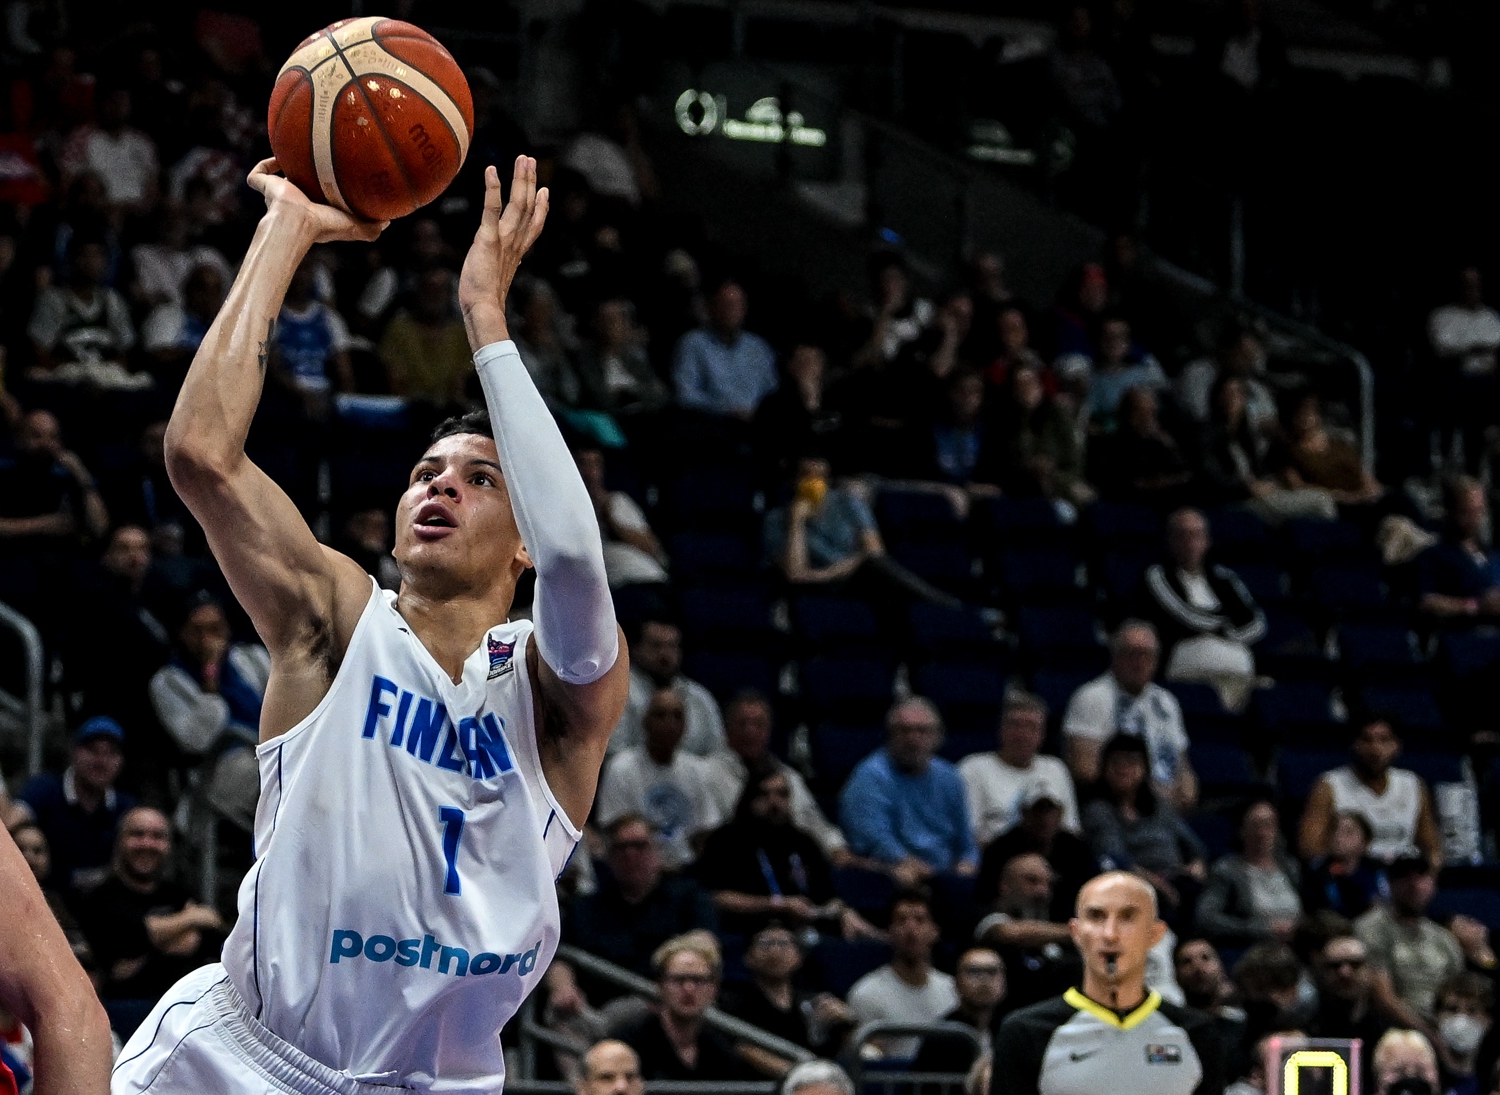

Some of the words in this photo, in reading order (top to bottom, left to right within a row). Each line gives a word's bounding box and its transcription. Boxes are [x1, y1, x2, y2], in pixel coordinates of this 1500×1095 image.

[361, 674, 515, 782] FINLAN
[438, 805, 467, 897] 1
[329, 929, 543, 977] postnord
